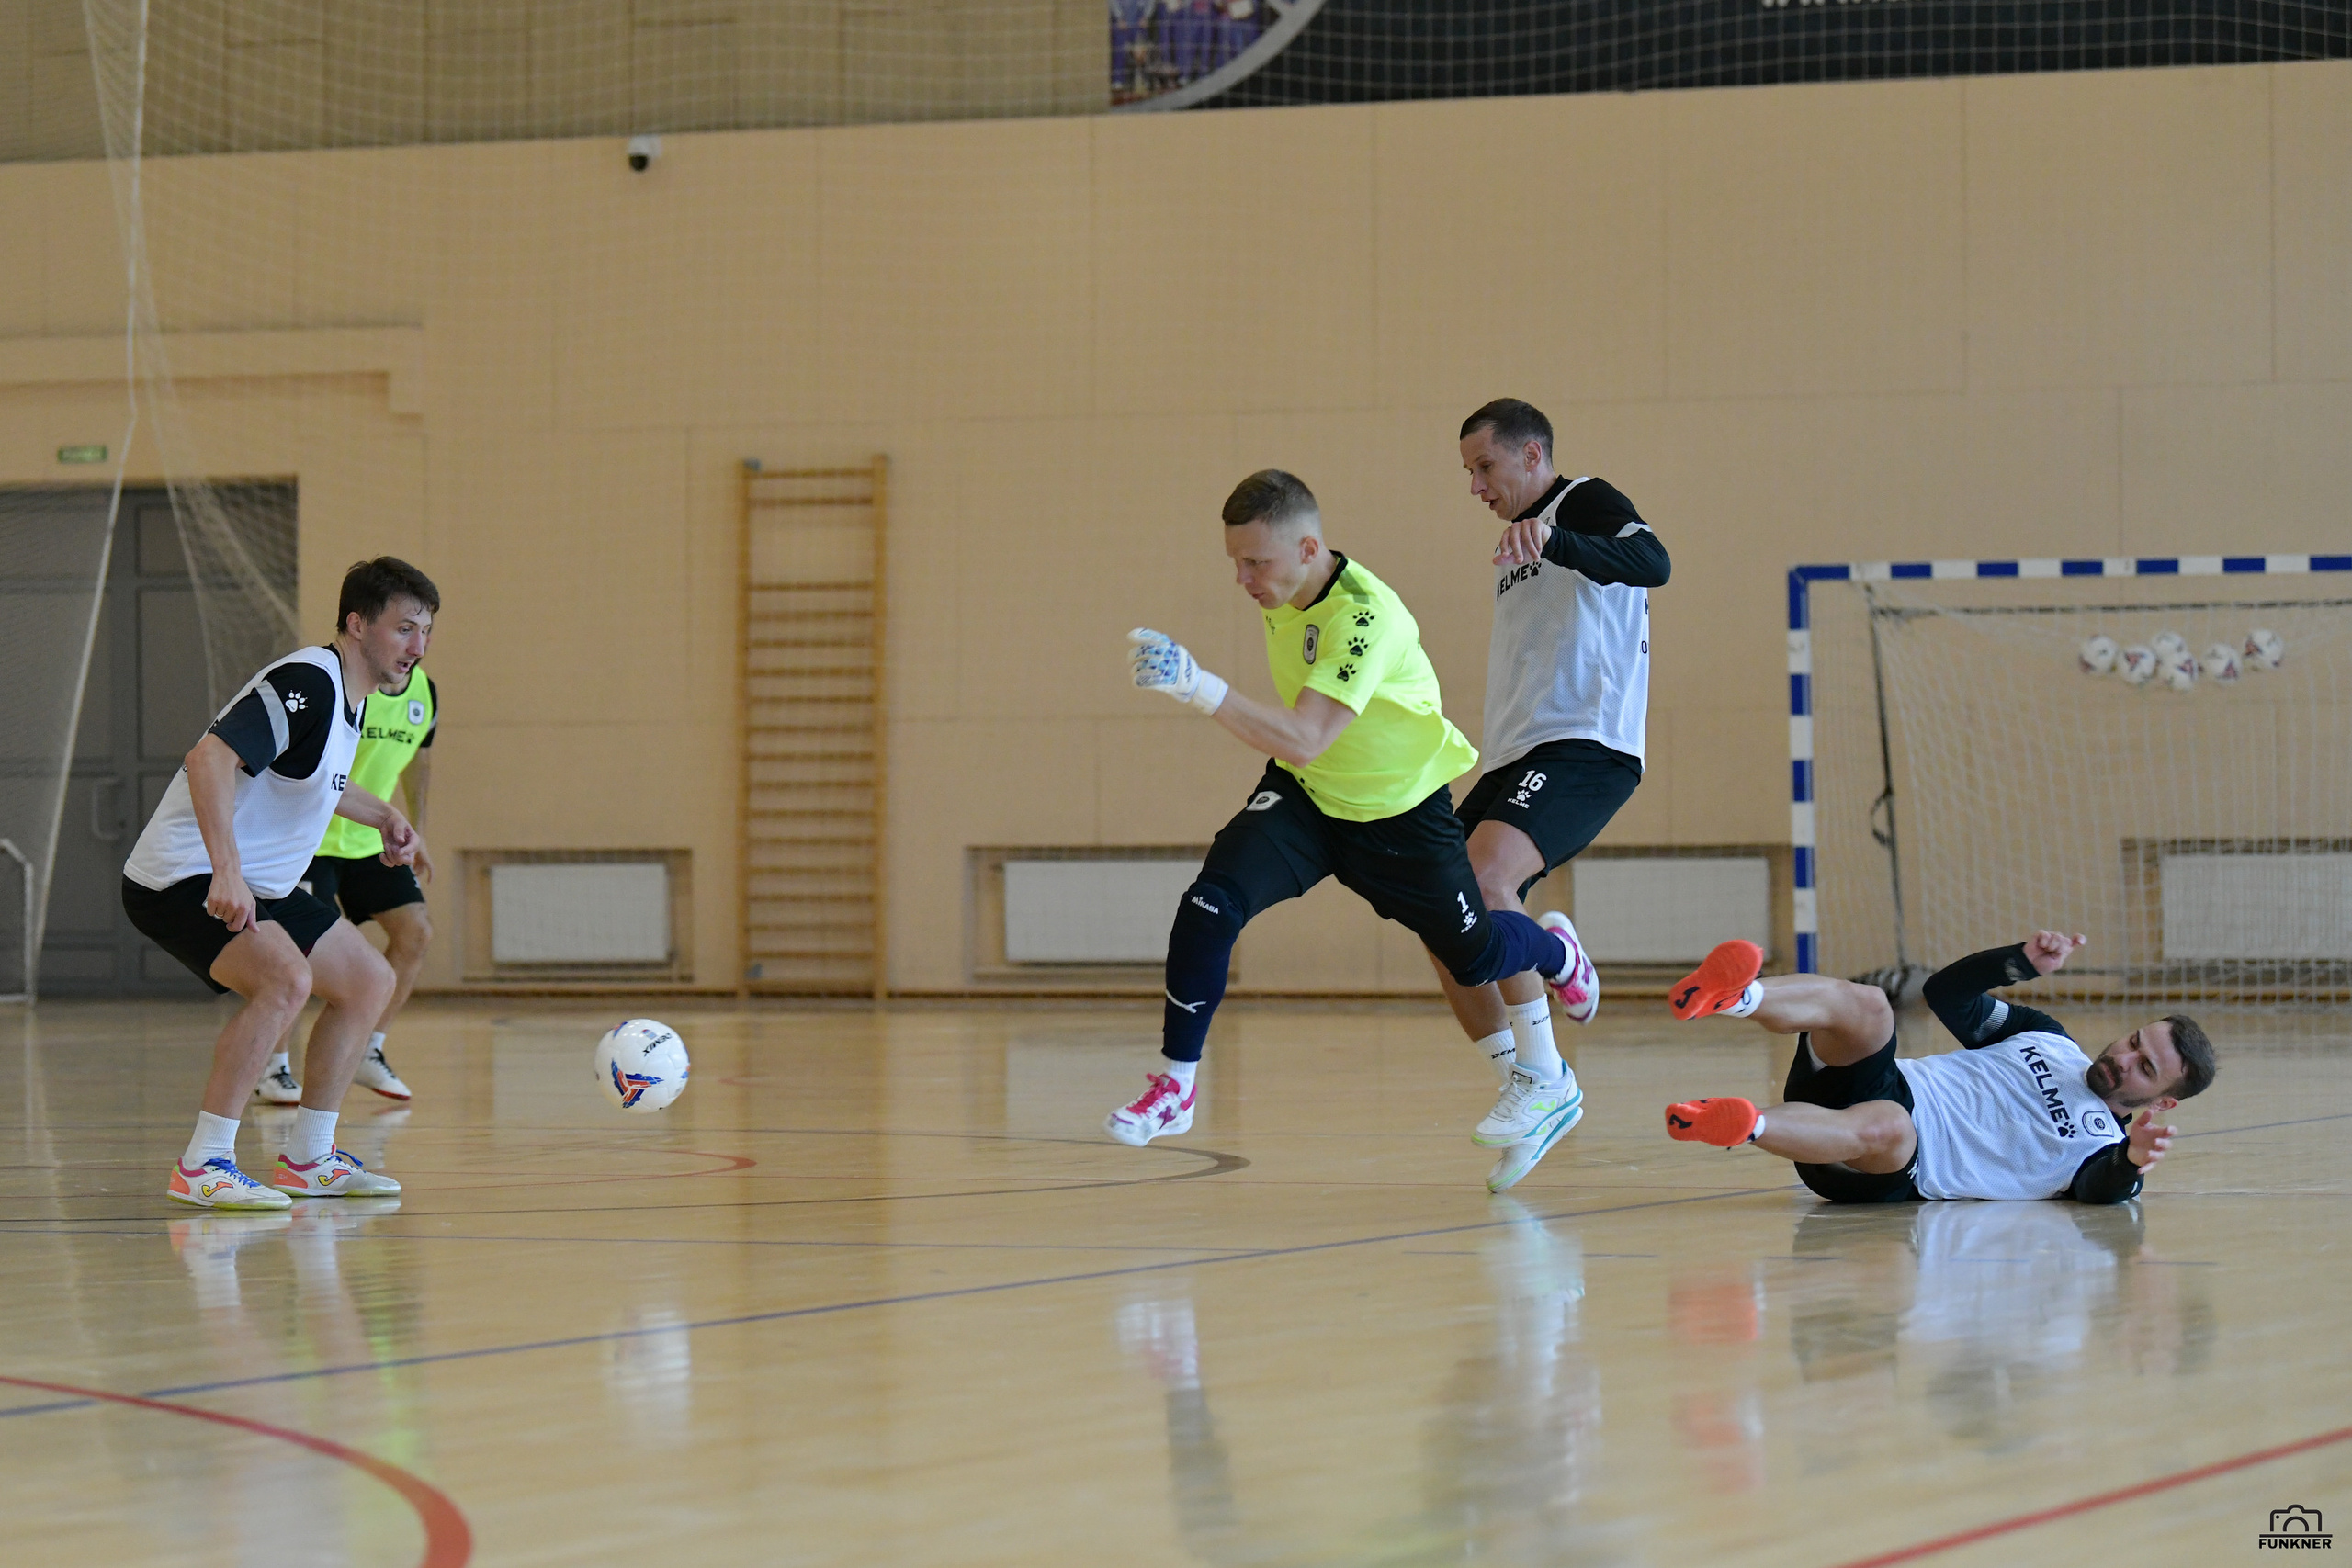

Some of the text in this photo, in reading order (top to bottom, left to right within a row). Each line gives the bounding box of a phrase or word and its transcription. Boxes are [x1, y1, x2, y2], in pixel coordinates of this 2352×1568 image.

[1518, 770, 1547, 792] 16
[1507, 797, 1530, 809] KELME
[1457, 891, 1469, 914] 1
[2019, 1046, 2070, 1123] KELME
